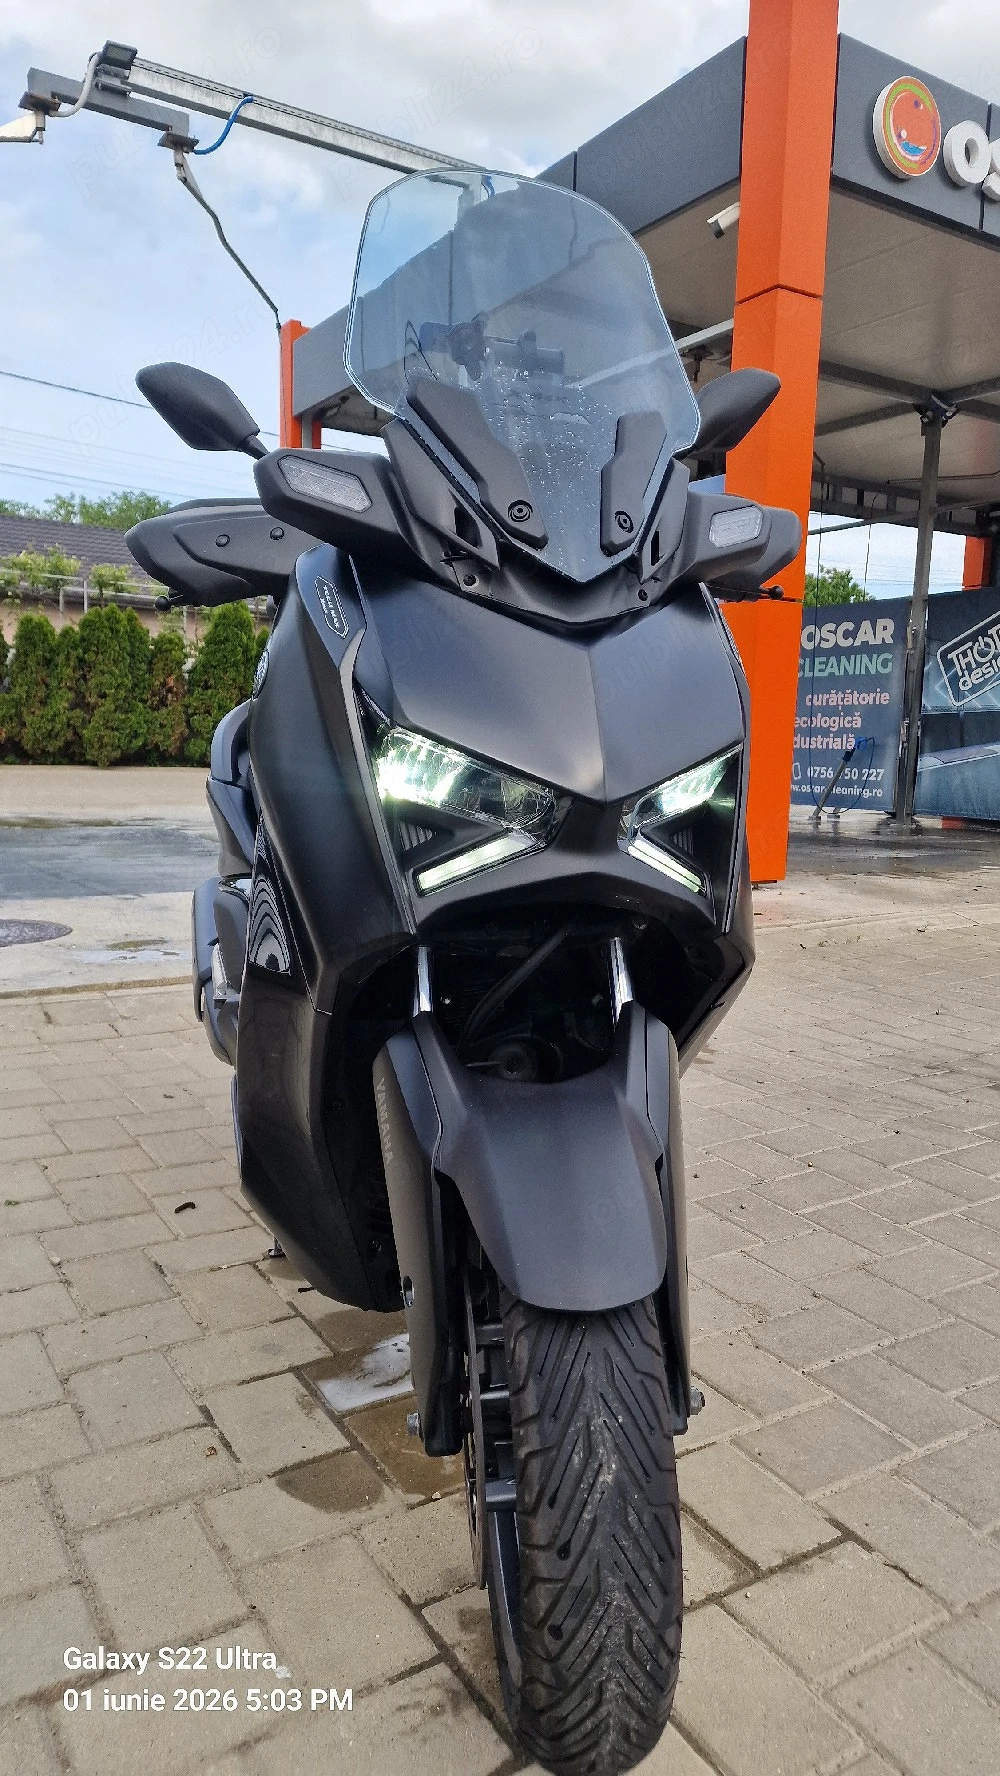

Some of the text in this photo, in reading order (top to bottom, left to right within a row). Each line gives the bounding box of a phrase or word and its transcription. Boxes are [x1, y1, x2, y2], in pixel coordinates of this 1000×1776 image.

[801, 618, 895, 650] OSCAR
[958, 656, 1000, 691] desi
[805, 688, 890, 711] curățătorie
[794, 711, 862, 732] ecologică
[806, 765, 834, 779] 0756
[861, 768, 885, 781] 227
